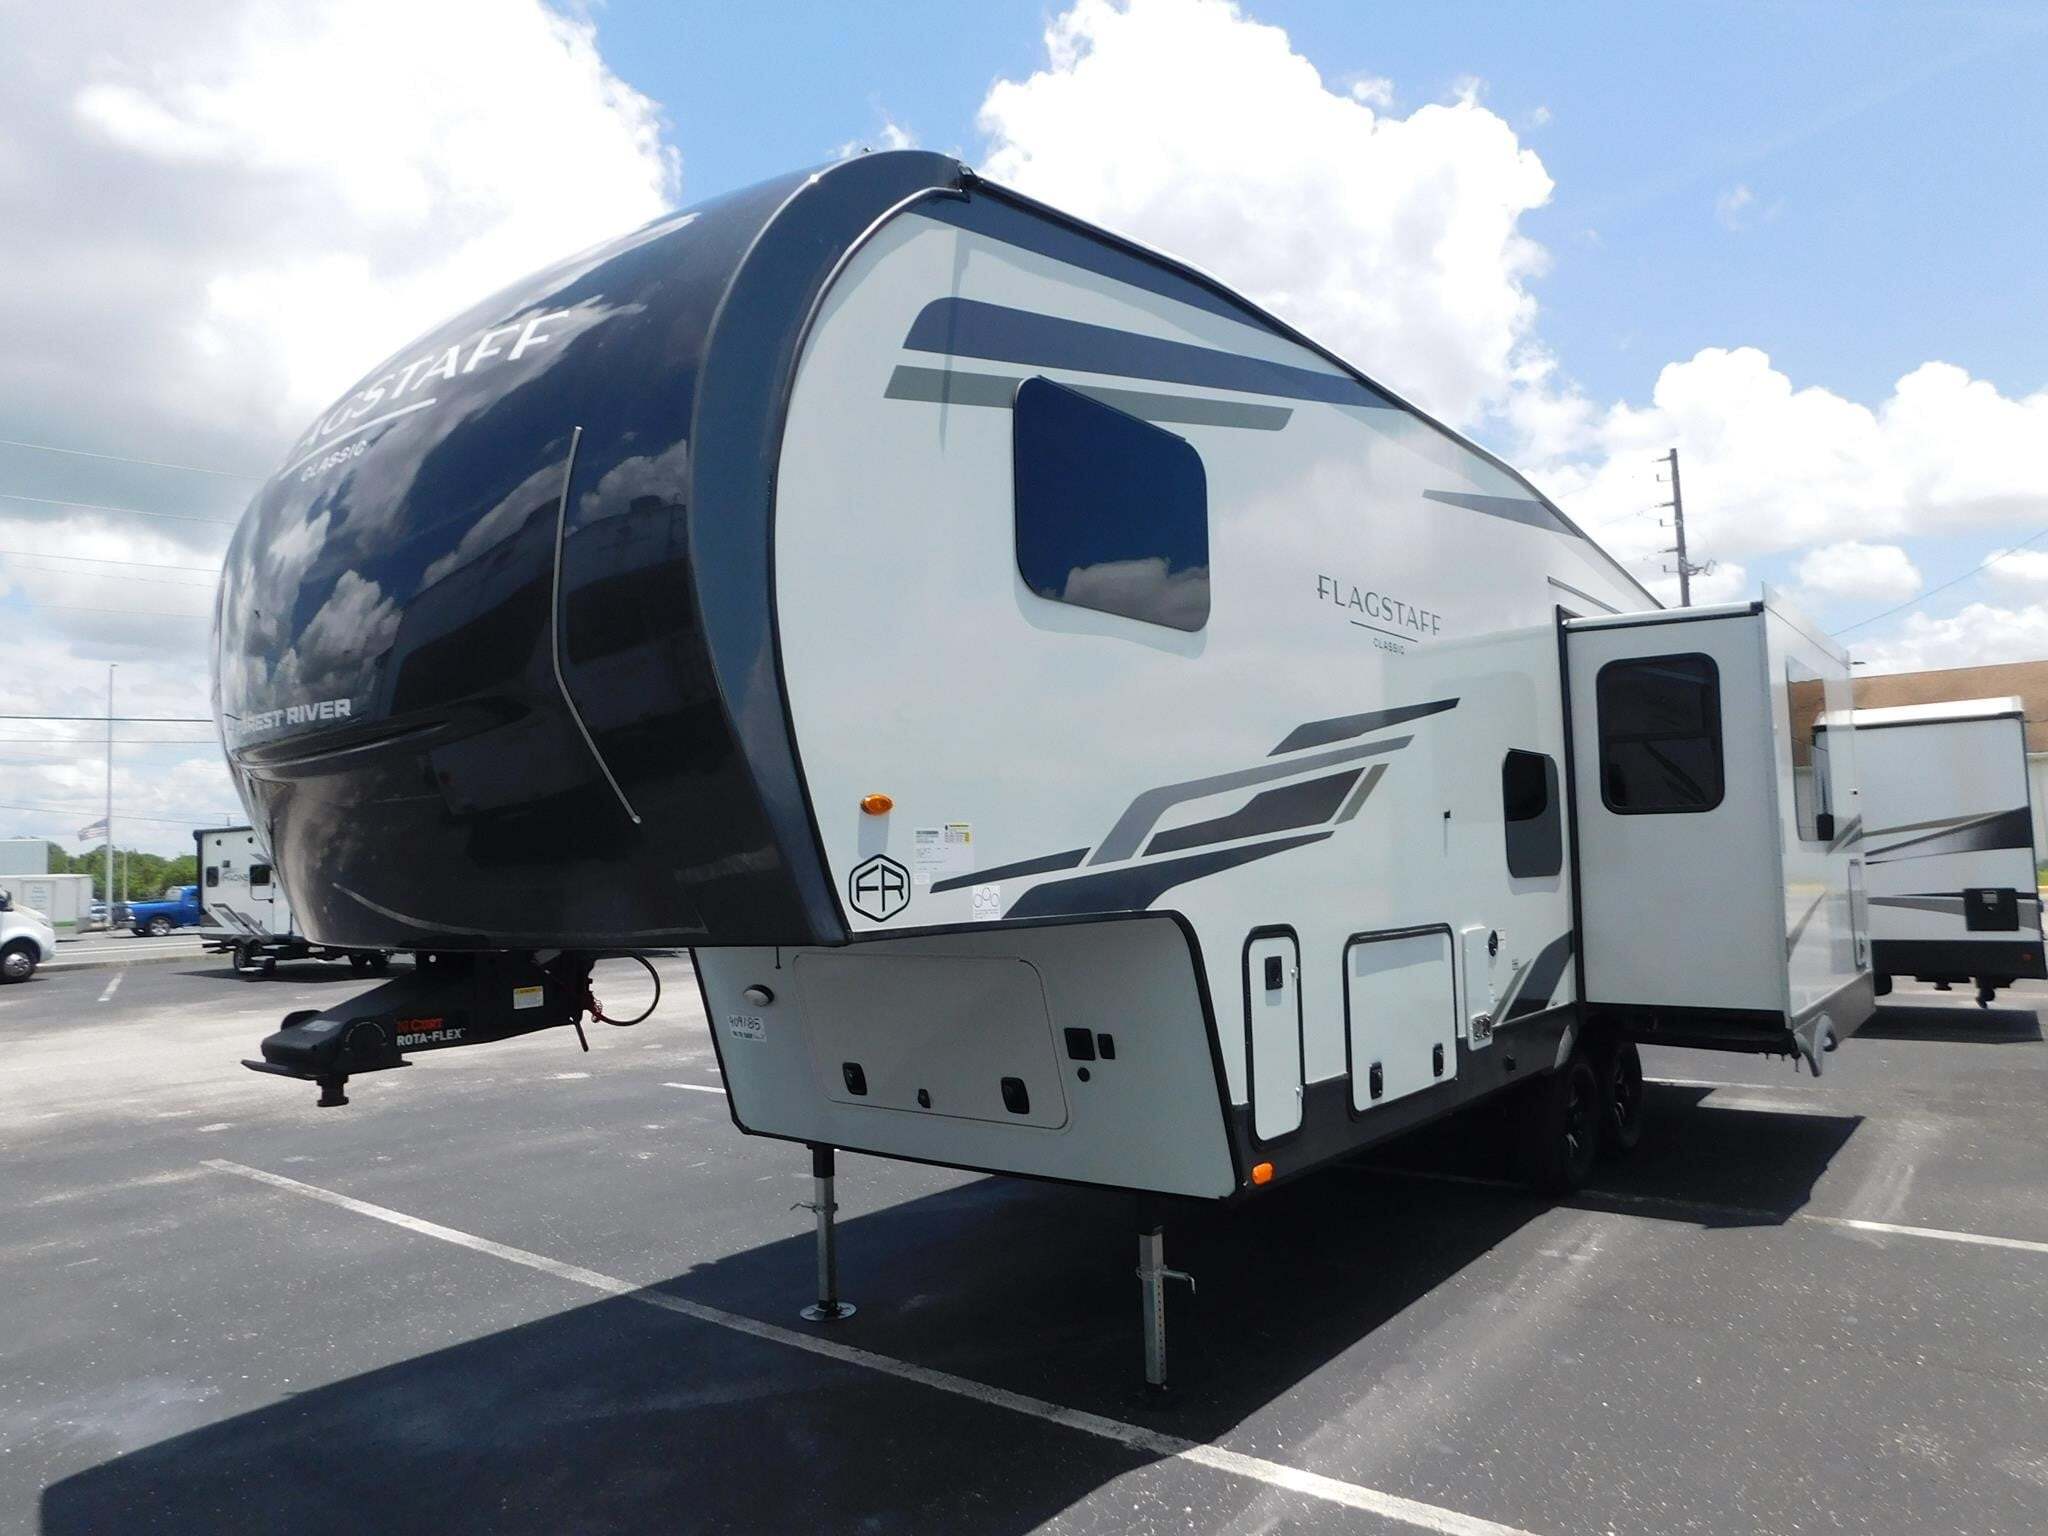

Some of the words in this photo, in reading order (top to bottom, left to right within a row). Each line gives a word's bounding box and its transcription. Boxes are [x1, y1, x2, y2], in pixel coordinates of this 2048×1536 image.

[298, 310, 569, 447] AGSTAFF
[301, 439, 368, 482] CLASSIC
[1317, 574, 1441, 636] FLAGSTAFF
[1372, 638, 1405, 655] CLASSIC
[285, 699, 352, 725] RIVER
